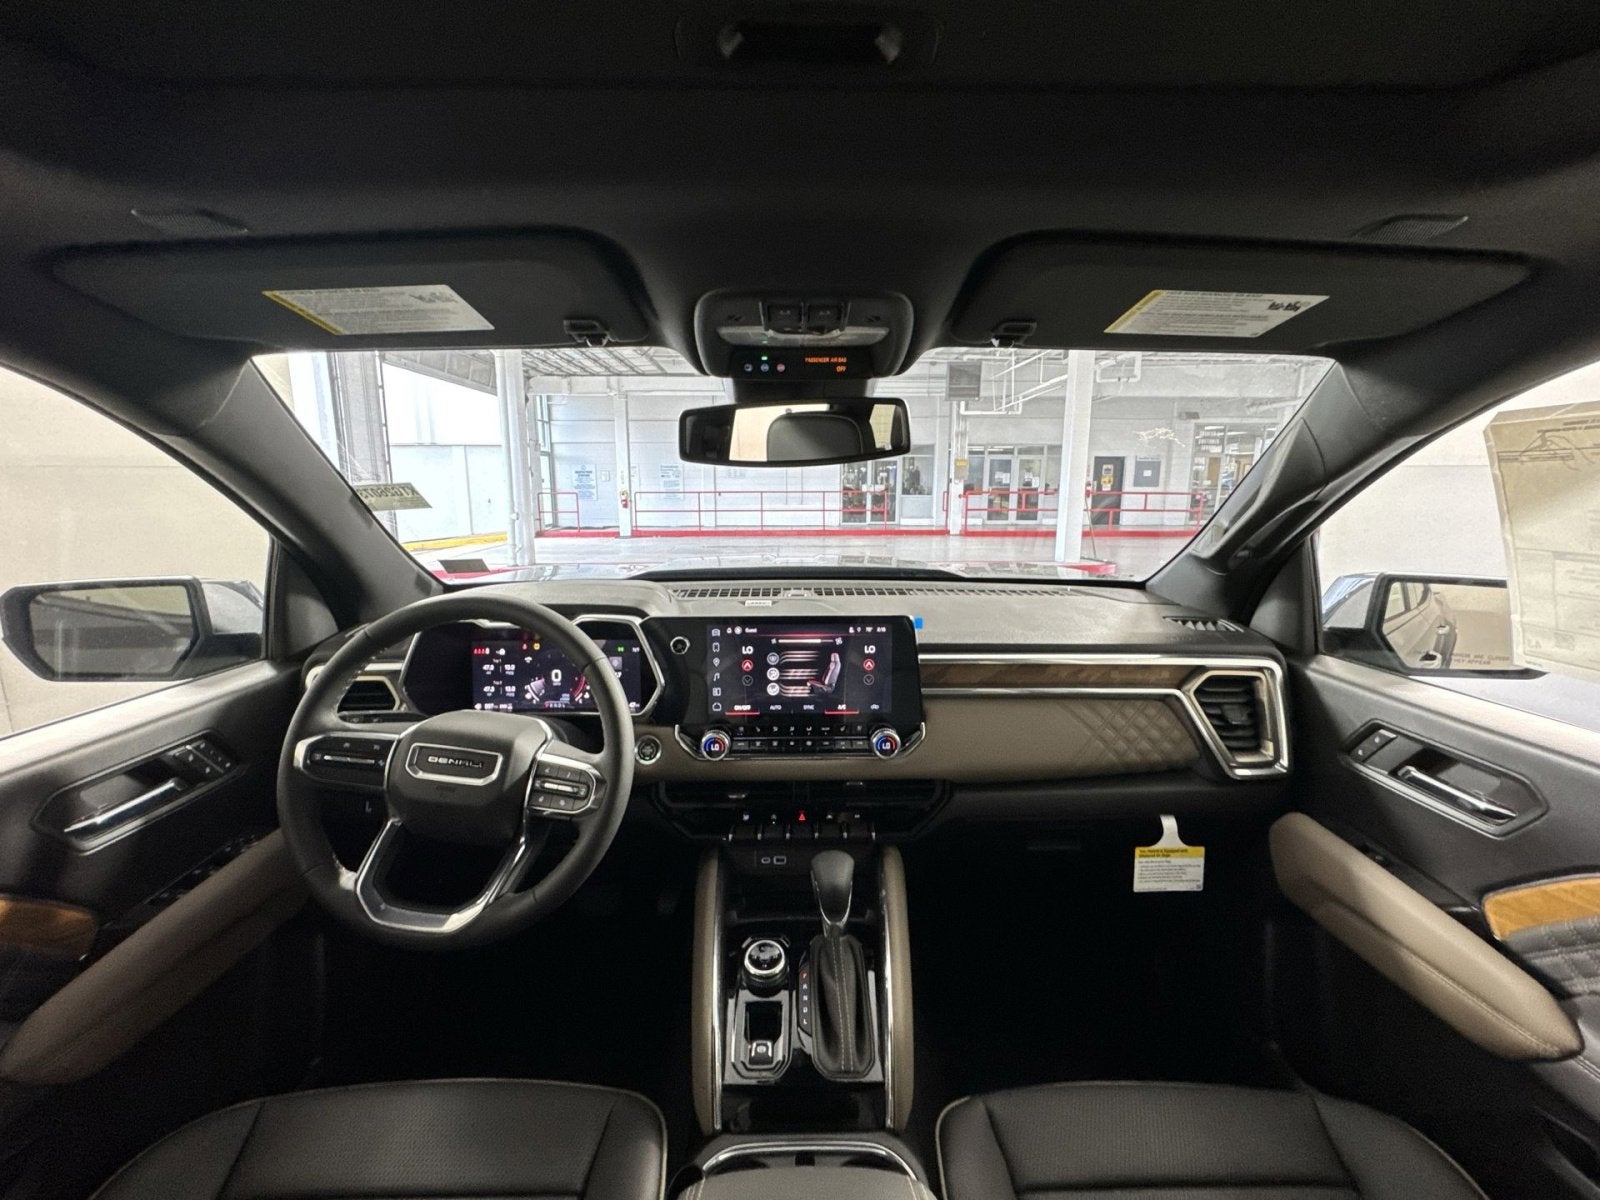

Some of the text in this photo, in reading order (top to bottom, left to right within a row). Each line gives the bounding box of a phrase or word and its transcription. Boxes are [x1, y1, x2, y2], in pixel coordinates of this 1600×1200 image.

[742, 646, 754, 654] LO
[864, 645, 876, 653] LO
[551, 669, 562, 682] 0
[711, 743, 720, 751] LO
[428, 756, 482, 768] DENALI
